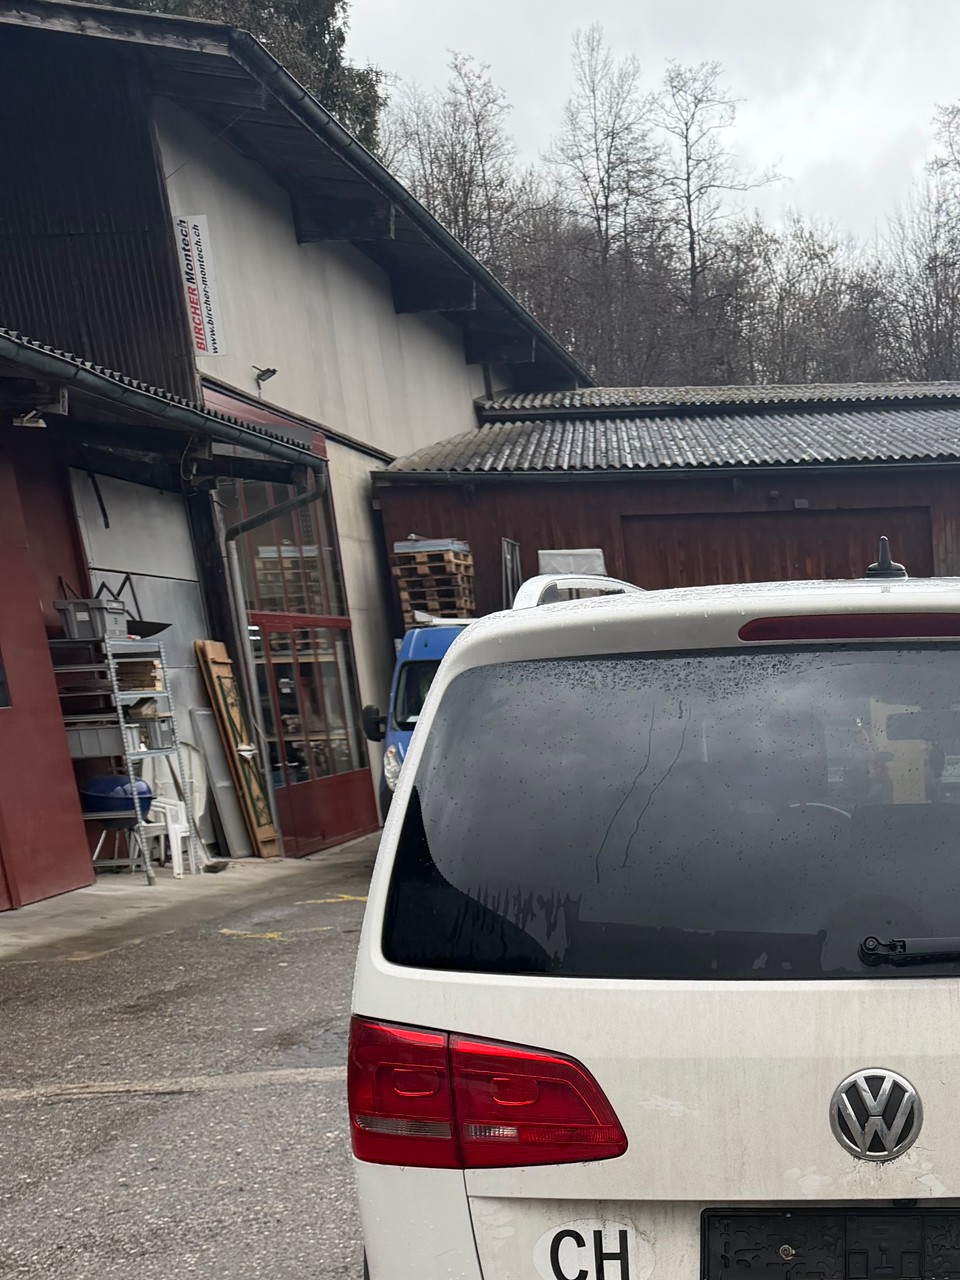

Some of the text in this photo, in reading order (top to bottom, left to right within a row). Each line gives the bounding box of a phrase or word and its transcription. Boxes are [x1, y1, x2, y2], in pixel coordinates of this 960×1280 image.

[177, 219, 206, 351] BIRCHER Montech
[191, 224, 219, 354] www.bircher-montech.ch
[830, 1067, 922, 1161] VW
